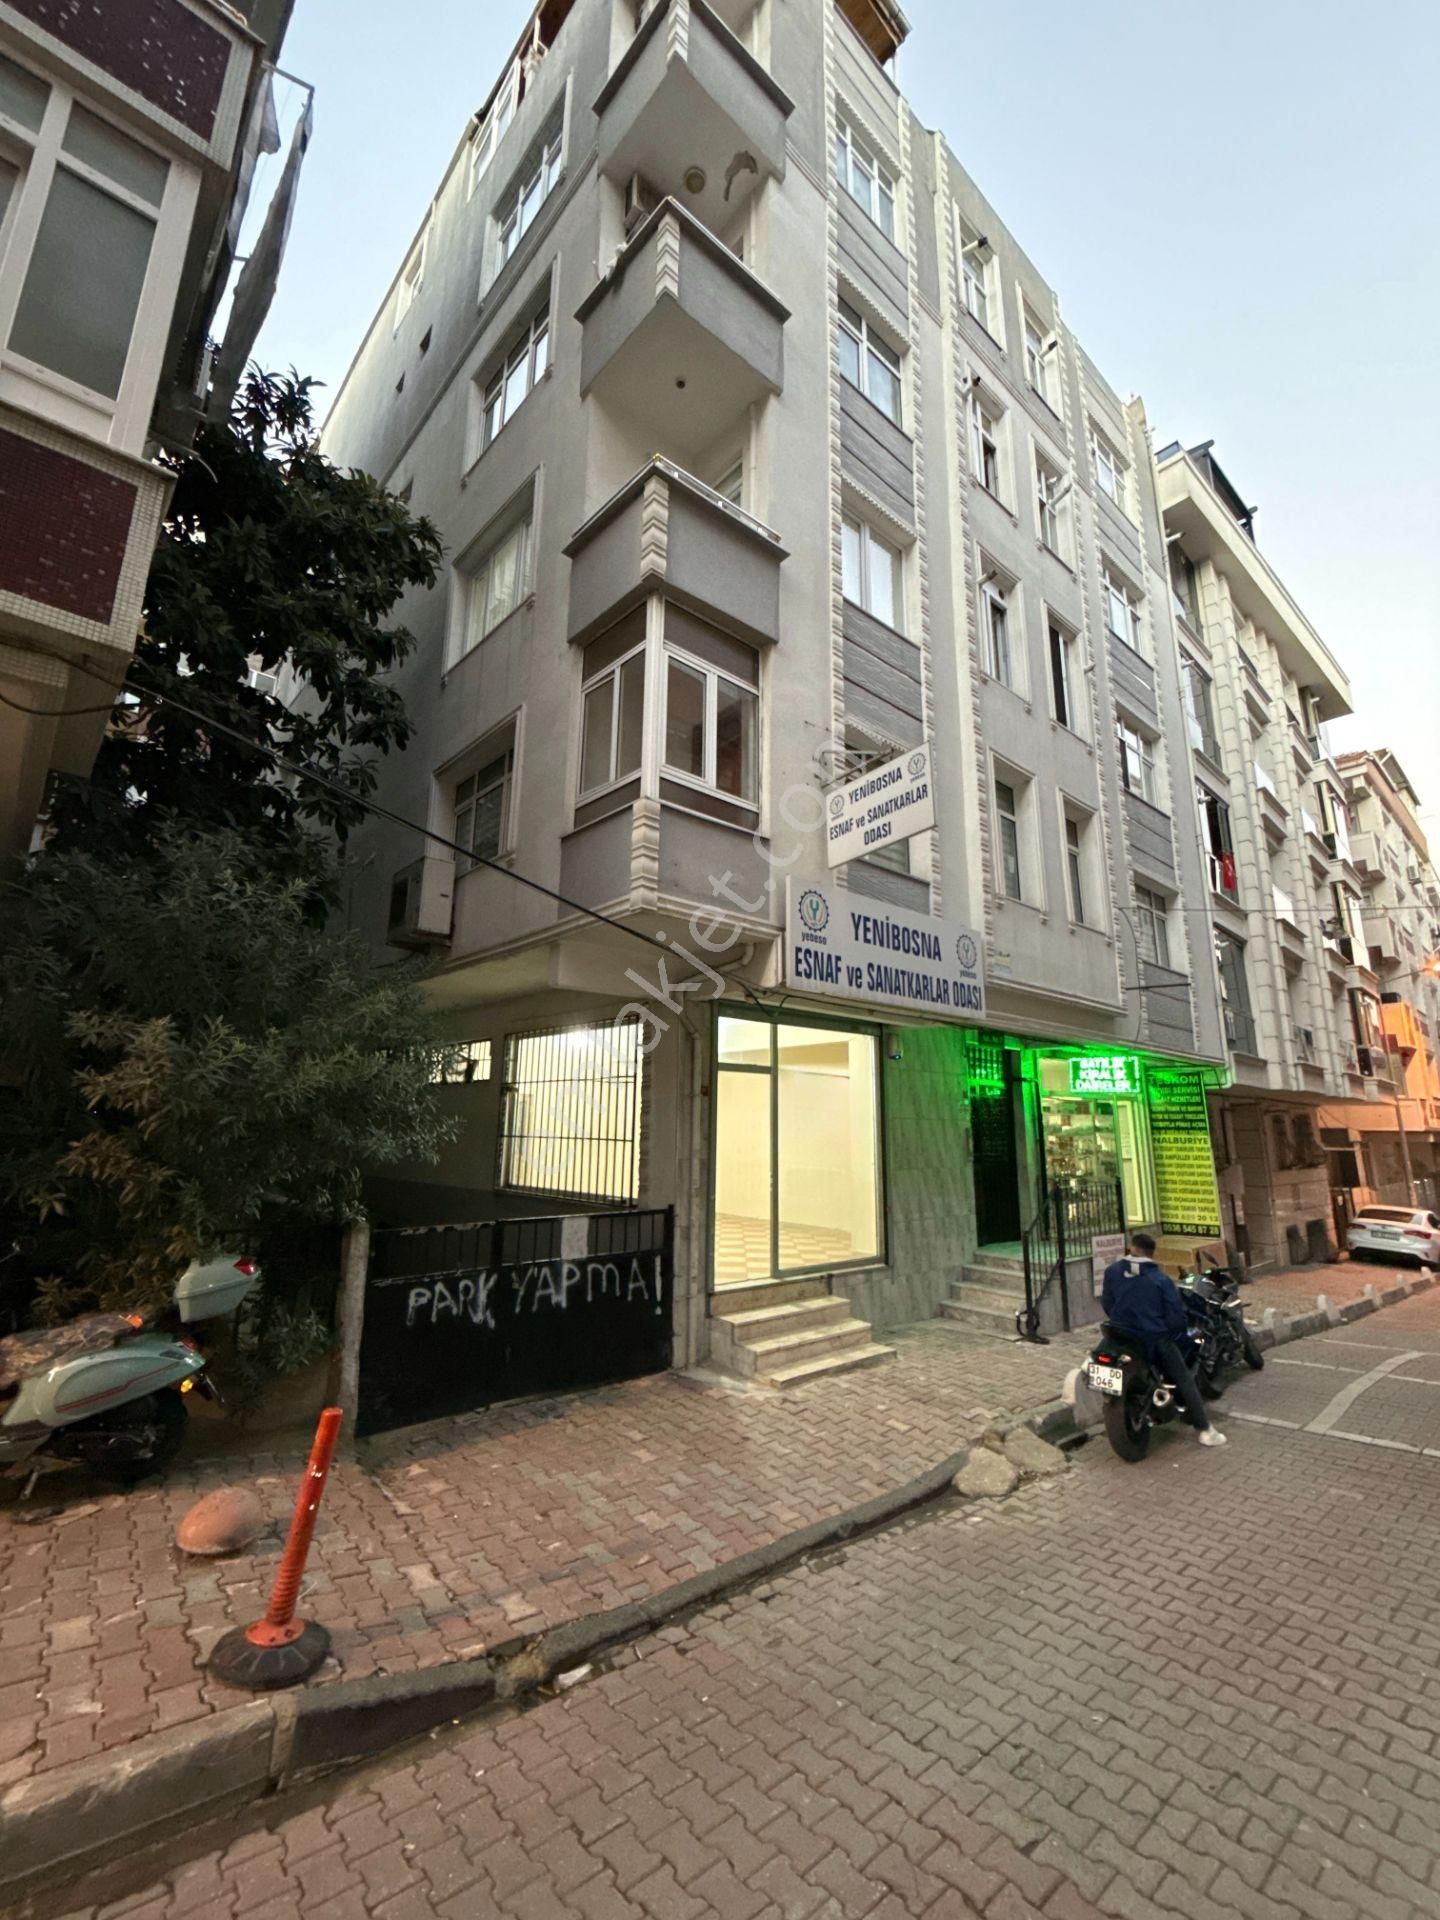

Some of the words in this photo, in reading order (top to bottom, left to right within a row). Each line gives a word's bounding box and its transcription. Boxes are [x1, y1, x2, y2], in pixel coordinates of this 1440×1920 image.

[849, 767, 902, 805] YENİBOSNA
[829, 818, 854, 840] ESNAF
[856, 816, 865, 828] ve
[867, 784, 928, 823] SANATKARLAR
[864, 821, 891, 845] ODASI
[851, 912, 942, 961] YENİBOSNA
[795, 946, 842, 984] ESNAF
[846, 965, 863, 988] ve
[867, 962, 950, 1005] SANATKARLAR
[953, 981, 982, 1011] ODASI
[406, 1270, 498, 1329] PARK
[1096, 1376, 1113, 1388] 046
